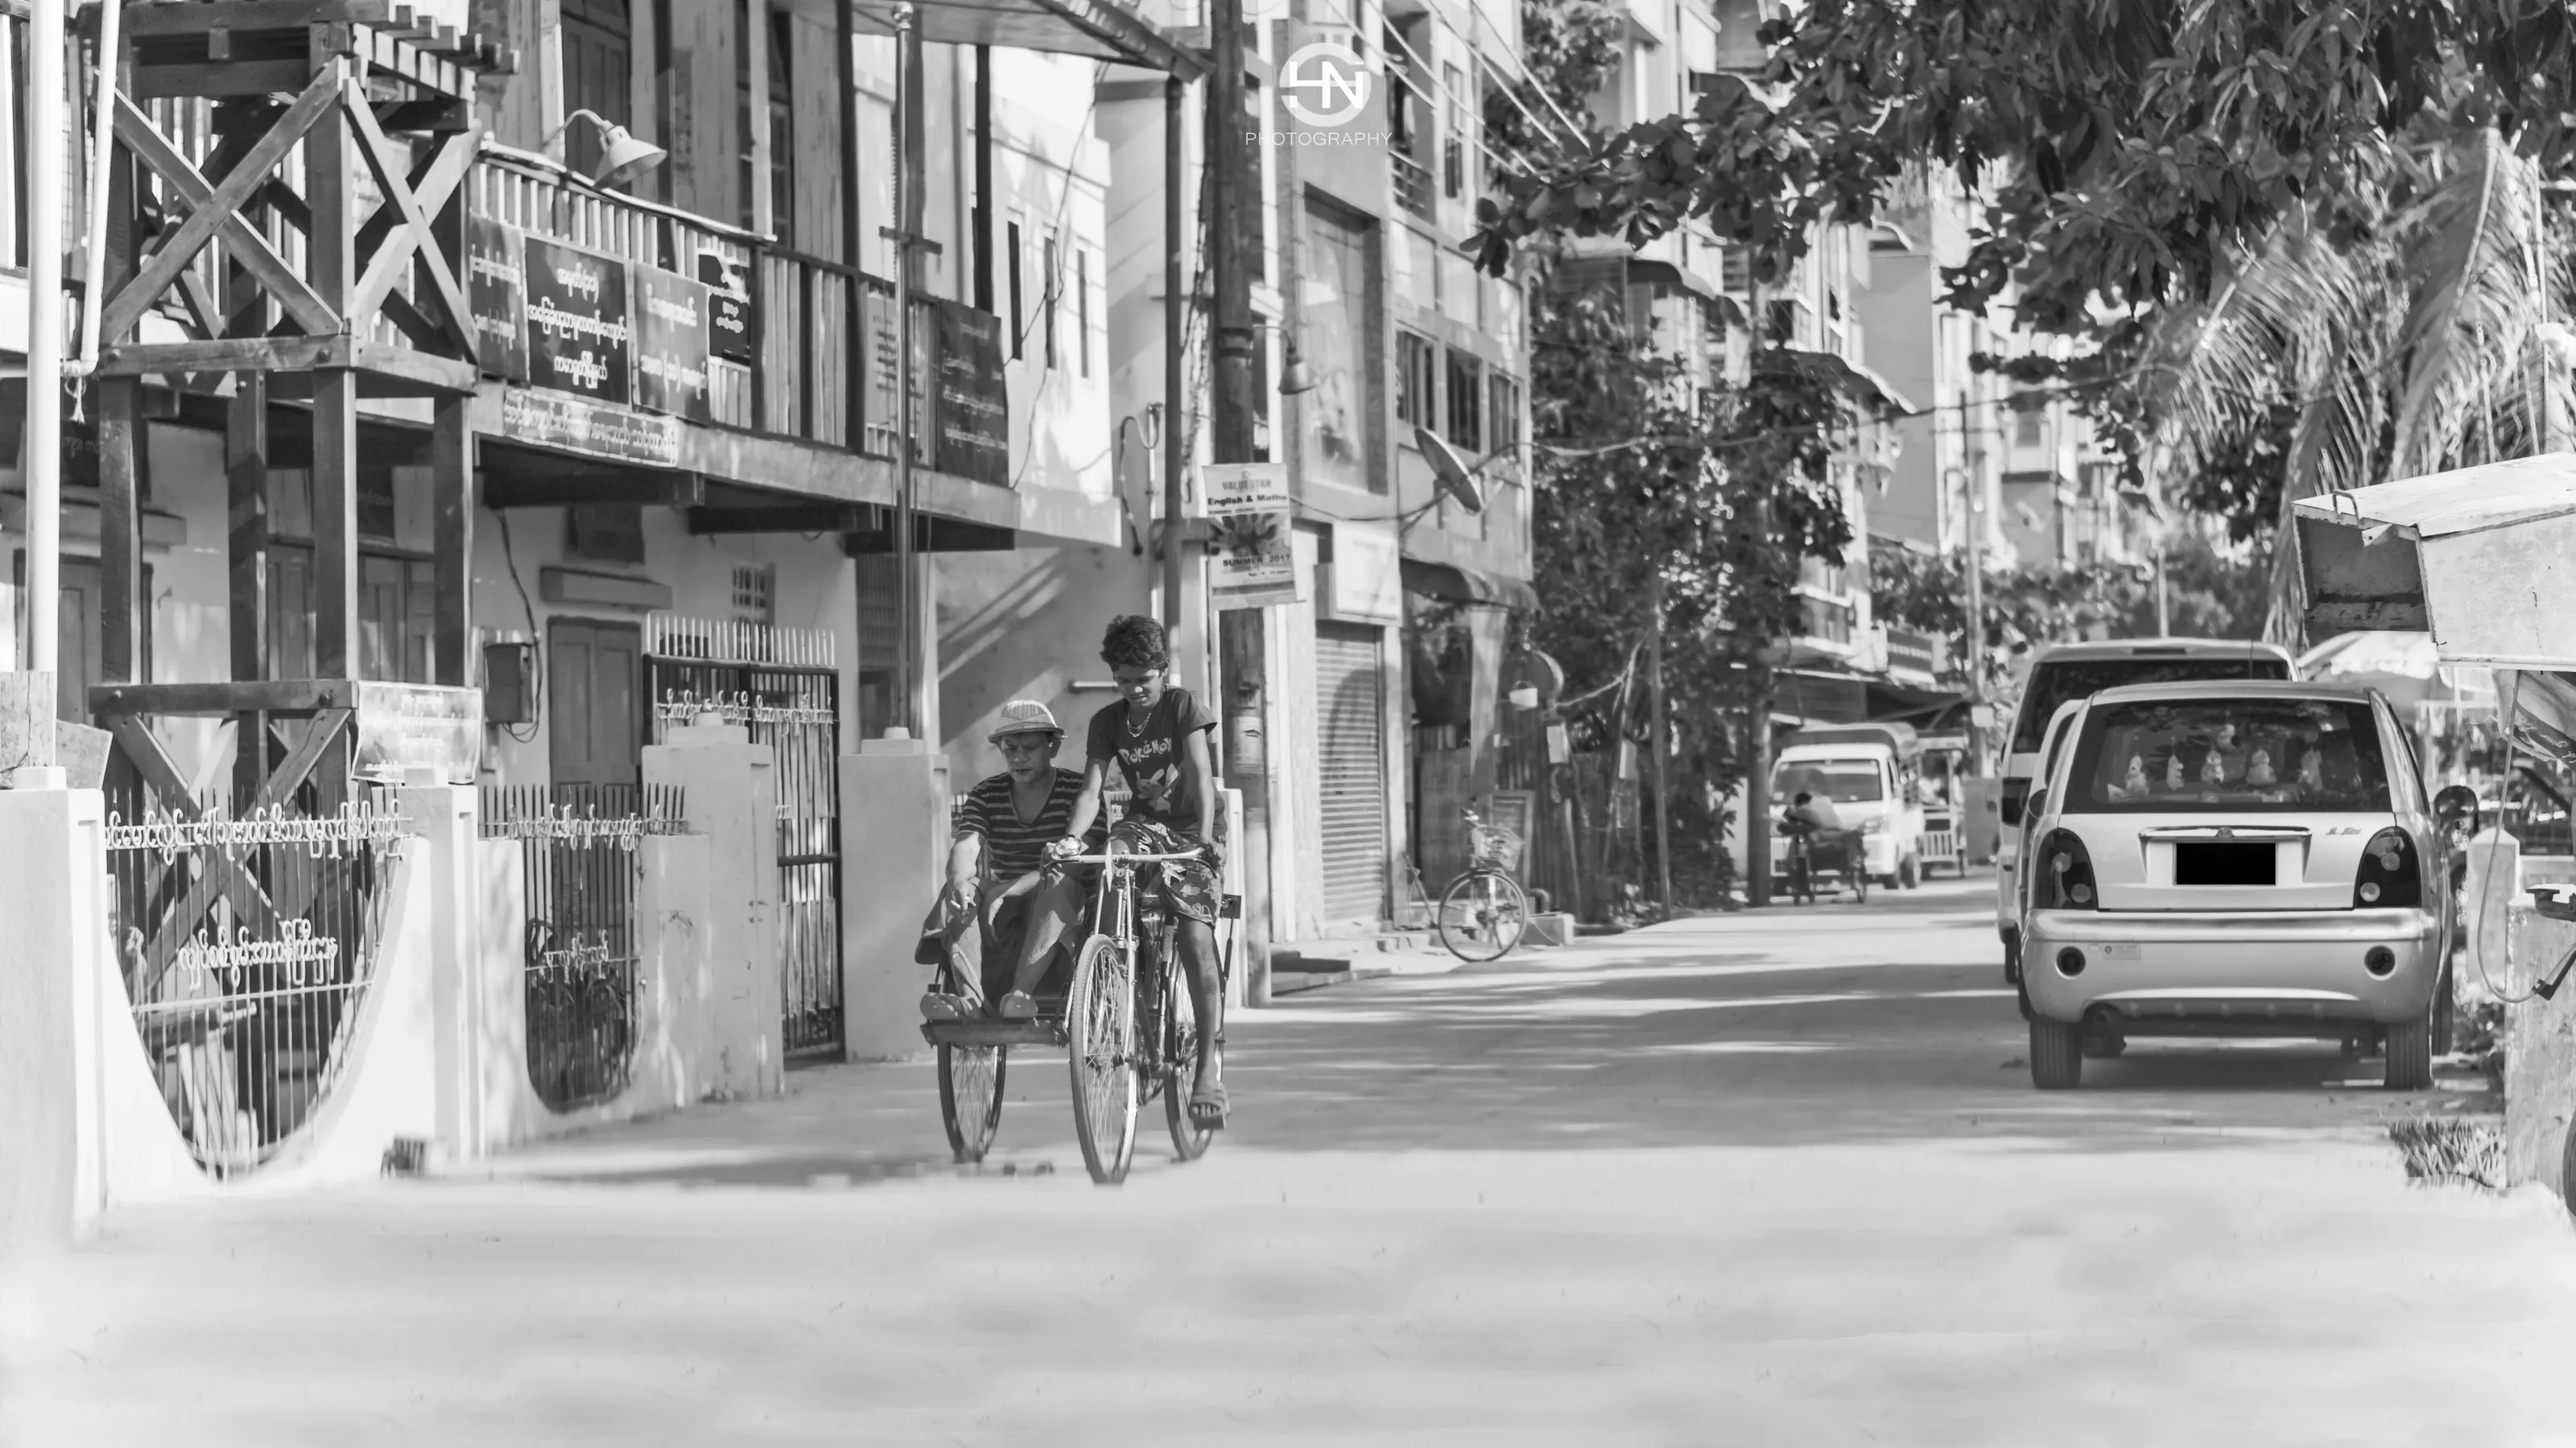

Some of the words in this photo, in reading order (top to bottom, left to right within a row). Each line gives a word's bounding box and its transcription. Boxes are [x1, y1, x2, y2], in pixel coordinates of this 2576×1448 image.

[1208, 496, 1243, 506] English
[1223, 556, 1263, 567] SUMMER
[1269, 554, 1291, 563] 2017
